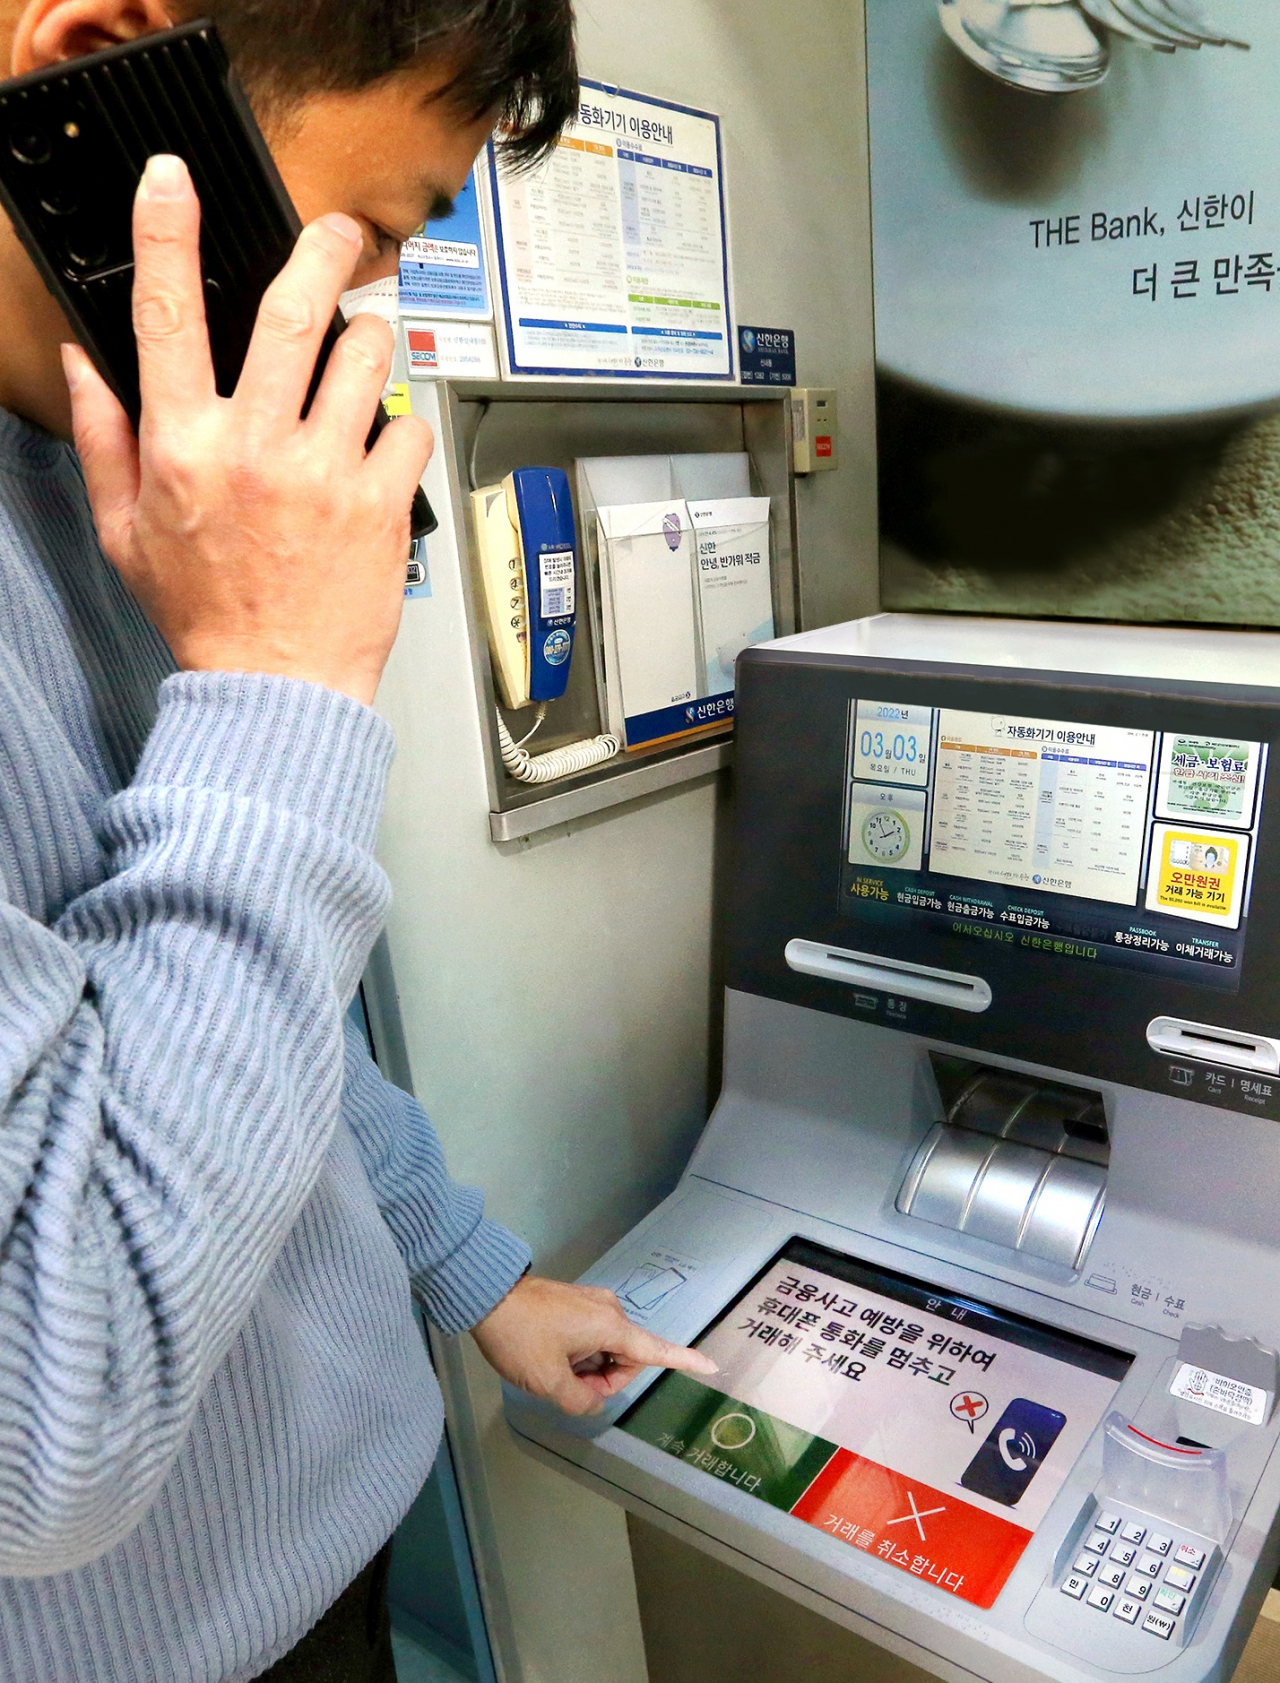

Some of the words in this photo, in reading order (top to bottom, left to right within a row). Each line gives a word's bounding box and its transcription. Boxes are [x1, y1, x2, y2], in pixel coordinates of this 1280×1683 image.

[578, 103, 626, 134] 동화기기
[630, 117, 673, 145] 이용안내
[1029, 215, 1080, 248] THE
[1091, 206, 1165, 242] Bank,
[1176, 190, 1255, 232] 신한이
[1132, 263, 1158, 302] 더
[1170, 260, 1200, 299] 큰
[1213, 252, 1280, 296] 만족
[756, 333, 788, 348] 신한은행
[411, 352, 436, 361] SECOM
[642, 358, 664, 368] 신한은행
[700, 542, 716, 554] 신한
[700, 558, 720, 570] 안녕,
[720, 554, 744, 568] 반가워
[744, 552, 760, 564] 적금
[554, 616, 572, 626] 신한은행
[697, 698, 734, 719] 신한은행
[878, 706, 908, 720] 2022년
[1007, 726, 1054, 740] 자동화기기
[1056, 730, 1096, 746] 이용안내
[861, 730, 892, 760] 03월
[893, 734, 926, 764] 03일
[870, 764, 890, 774] 목요일
[901, 768, 916, 776] THU
[1196, 770, 1218, 780] 사기
[880, 793, 893, 802] 오후
[862, 878, 884, 886] SERVICE
[1042, 877, 1072, 888] 신한은행
[1170, 872, 1220, 890] 오만원권
[850, 883, 890, 901] 사용가능
[904, 886, 917, 894] CASH
[918, 889, 936, 897] DEPOSIT
[1165, 885, 1183, 896] 거래
[1186, 888, 1204, 900] 가능
[1206, 891, 1225, 902] 기기
[896, 892, 942, 910] 현금입금가능
[950, 894, 962, 902] CASH
[962, 896, 994, 908] WITHDRAWAL
[947, 901, 994, 919] 현금출금가능
[1008, 904, 1024, 912] CHECK
[1024, 908, 1044, 916] DEPOSIT
[1000, 912, 1050, 930] 수표입금가능
[1129, 926, 1157, 936] PASSBOOK
[952, 922, 1014, 942] 어서오십시오
[1020, 936, 1098, 959] 신한은행입니다
[1114, 932, 1170, 952] 통장정리가능
[1192, 938, 1220, 948] TRANSFER
[1176, 943, 1234, 964] 이체거래가능
[1206, 1072, 1226, 1086] 카드
[1240, 1080, 1272, 1096] 명세표
[1132, 1284, 1152, 1300] 현금
[1164, 1296, 1186, 1310] 수표
[775, 1276, 858, 1318] 금융사고
[860, 1308, 924, 1344] 예방을
[927, 1333, 998, 1373] 위하여
[758, 1297, 821, 1332] 휴대폰
[819, 1320, 887, 1360] 통화를
[886, 1346, 956, 1386] 멈추고
[738, 1317, 803, 1354] 거래해
[802, 1343, 867, 1382] 주세요
[657, 1432, 686, 1455] 계속
[688, 1448, 762, 1492] 거래합니다
[1134, 1532, 1142, 1540] 2
[824, 1514, 876, 1548] 거래를
[877, 1539, 964, 1592] 취소합니다
[1098, 1542, 1104, 1550] 4
[1160, 1542, 1168, 1551] 3
[1181, 1544, 1196, 1556] 취소
[1122, 1552, 1131, 1562] 5
[1086, 1562, 1094, 1571] 7
[1150, 1564, 1157, 1573] 6
[1069, 1578, 1079, 1589] 만
[1112, 1574, 1120, 1584] 8
[1138, 1586, 1146, 1595] 9
[1100, 1596, 1108, 1606] 0
[1122, 1603, 1132, 1614] 천
